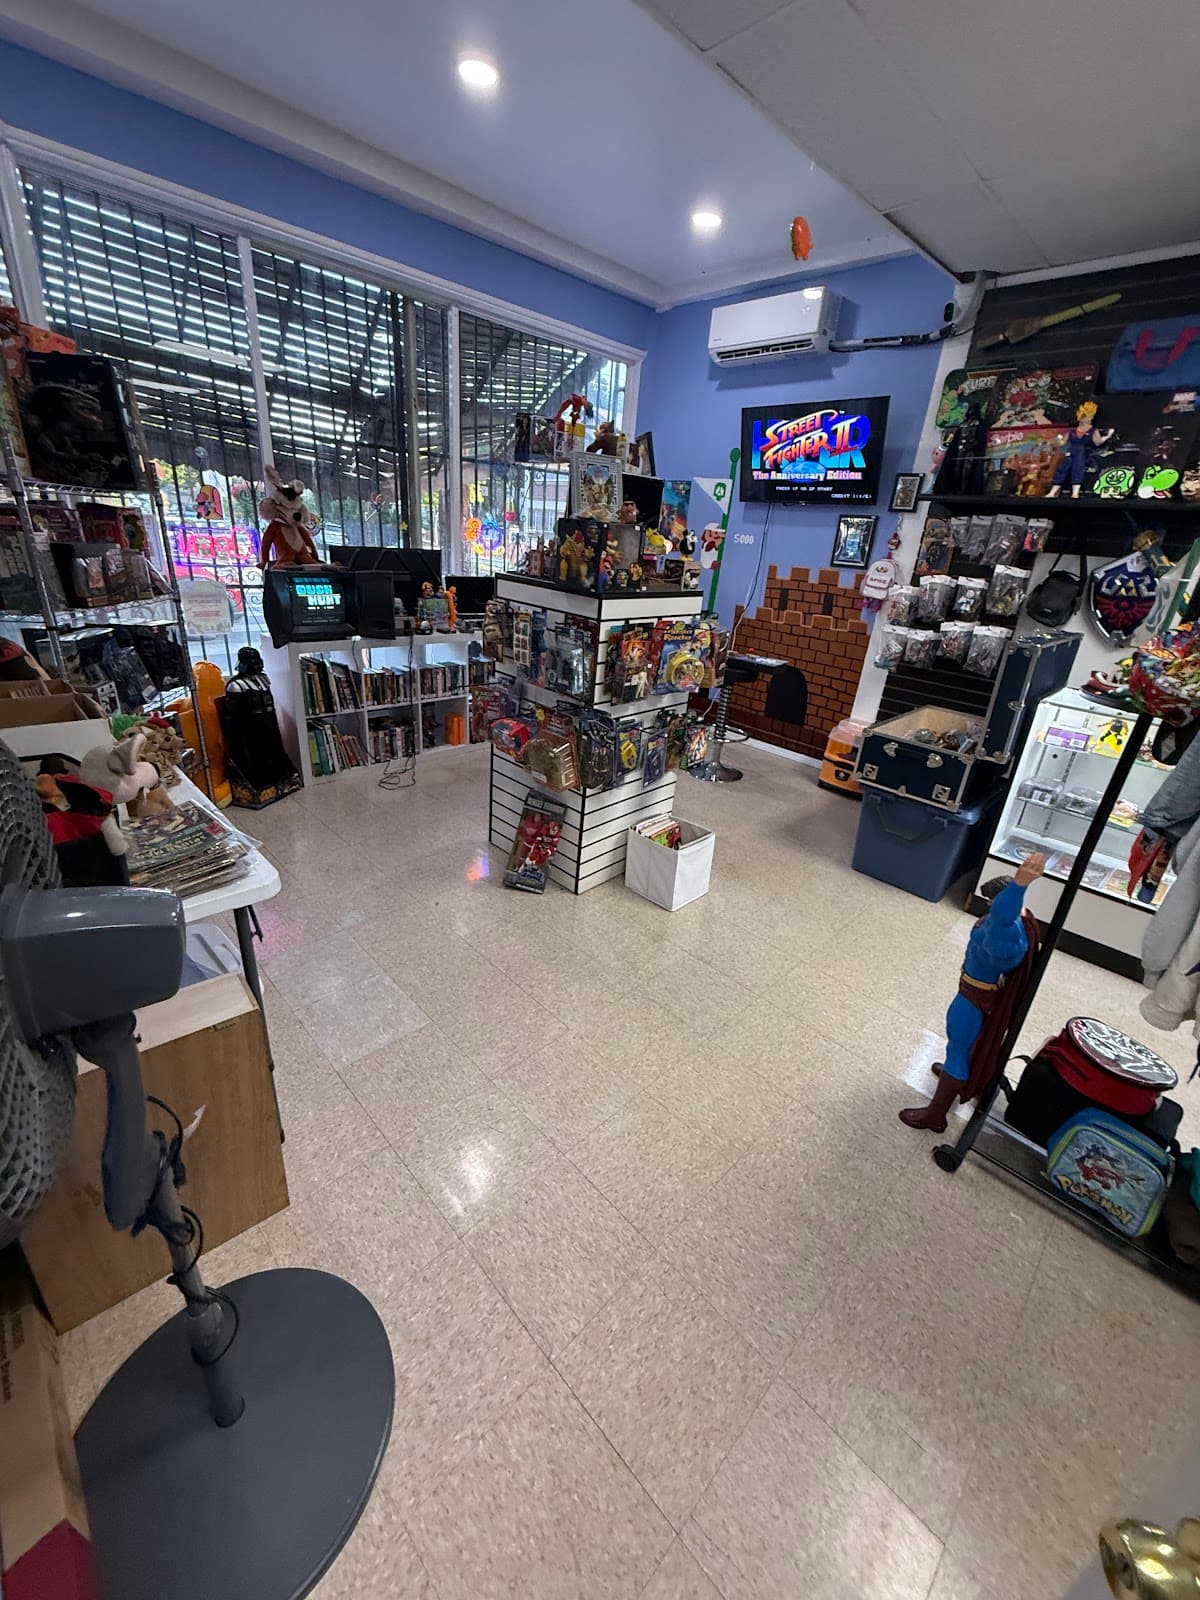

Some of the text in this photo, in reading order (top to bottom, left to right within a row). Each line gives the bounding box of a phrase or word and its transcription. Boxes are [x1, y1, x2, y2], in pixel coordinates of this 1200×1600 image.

[760, 409, 838, 450] STREET
[763, 428, 833, 469] FIGHTER
[752, 470, 863, 481] The Anniversary Edition
[295, 584, 332, 595] DUCK
[307, 595, 341, 606] HUNT
